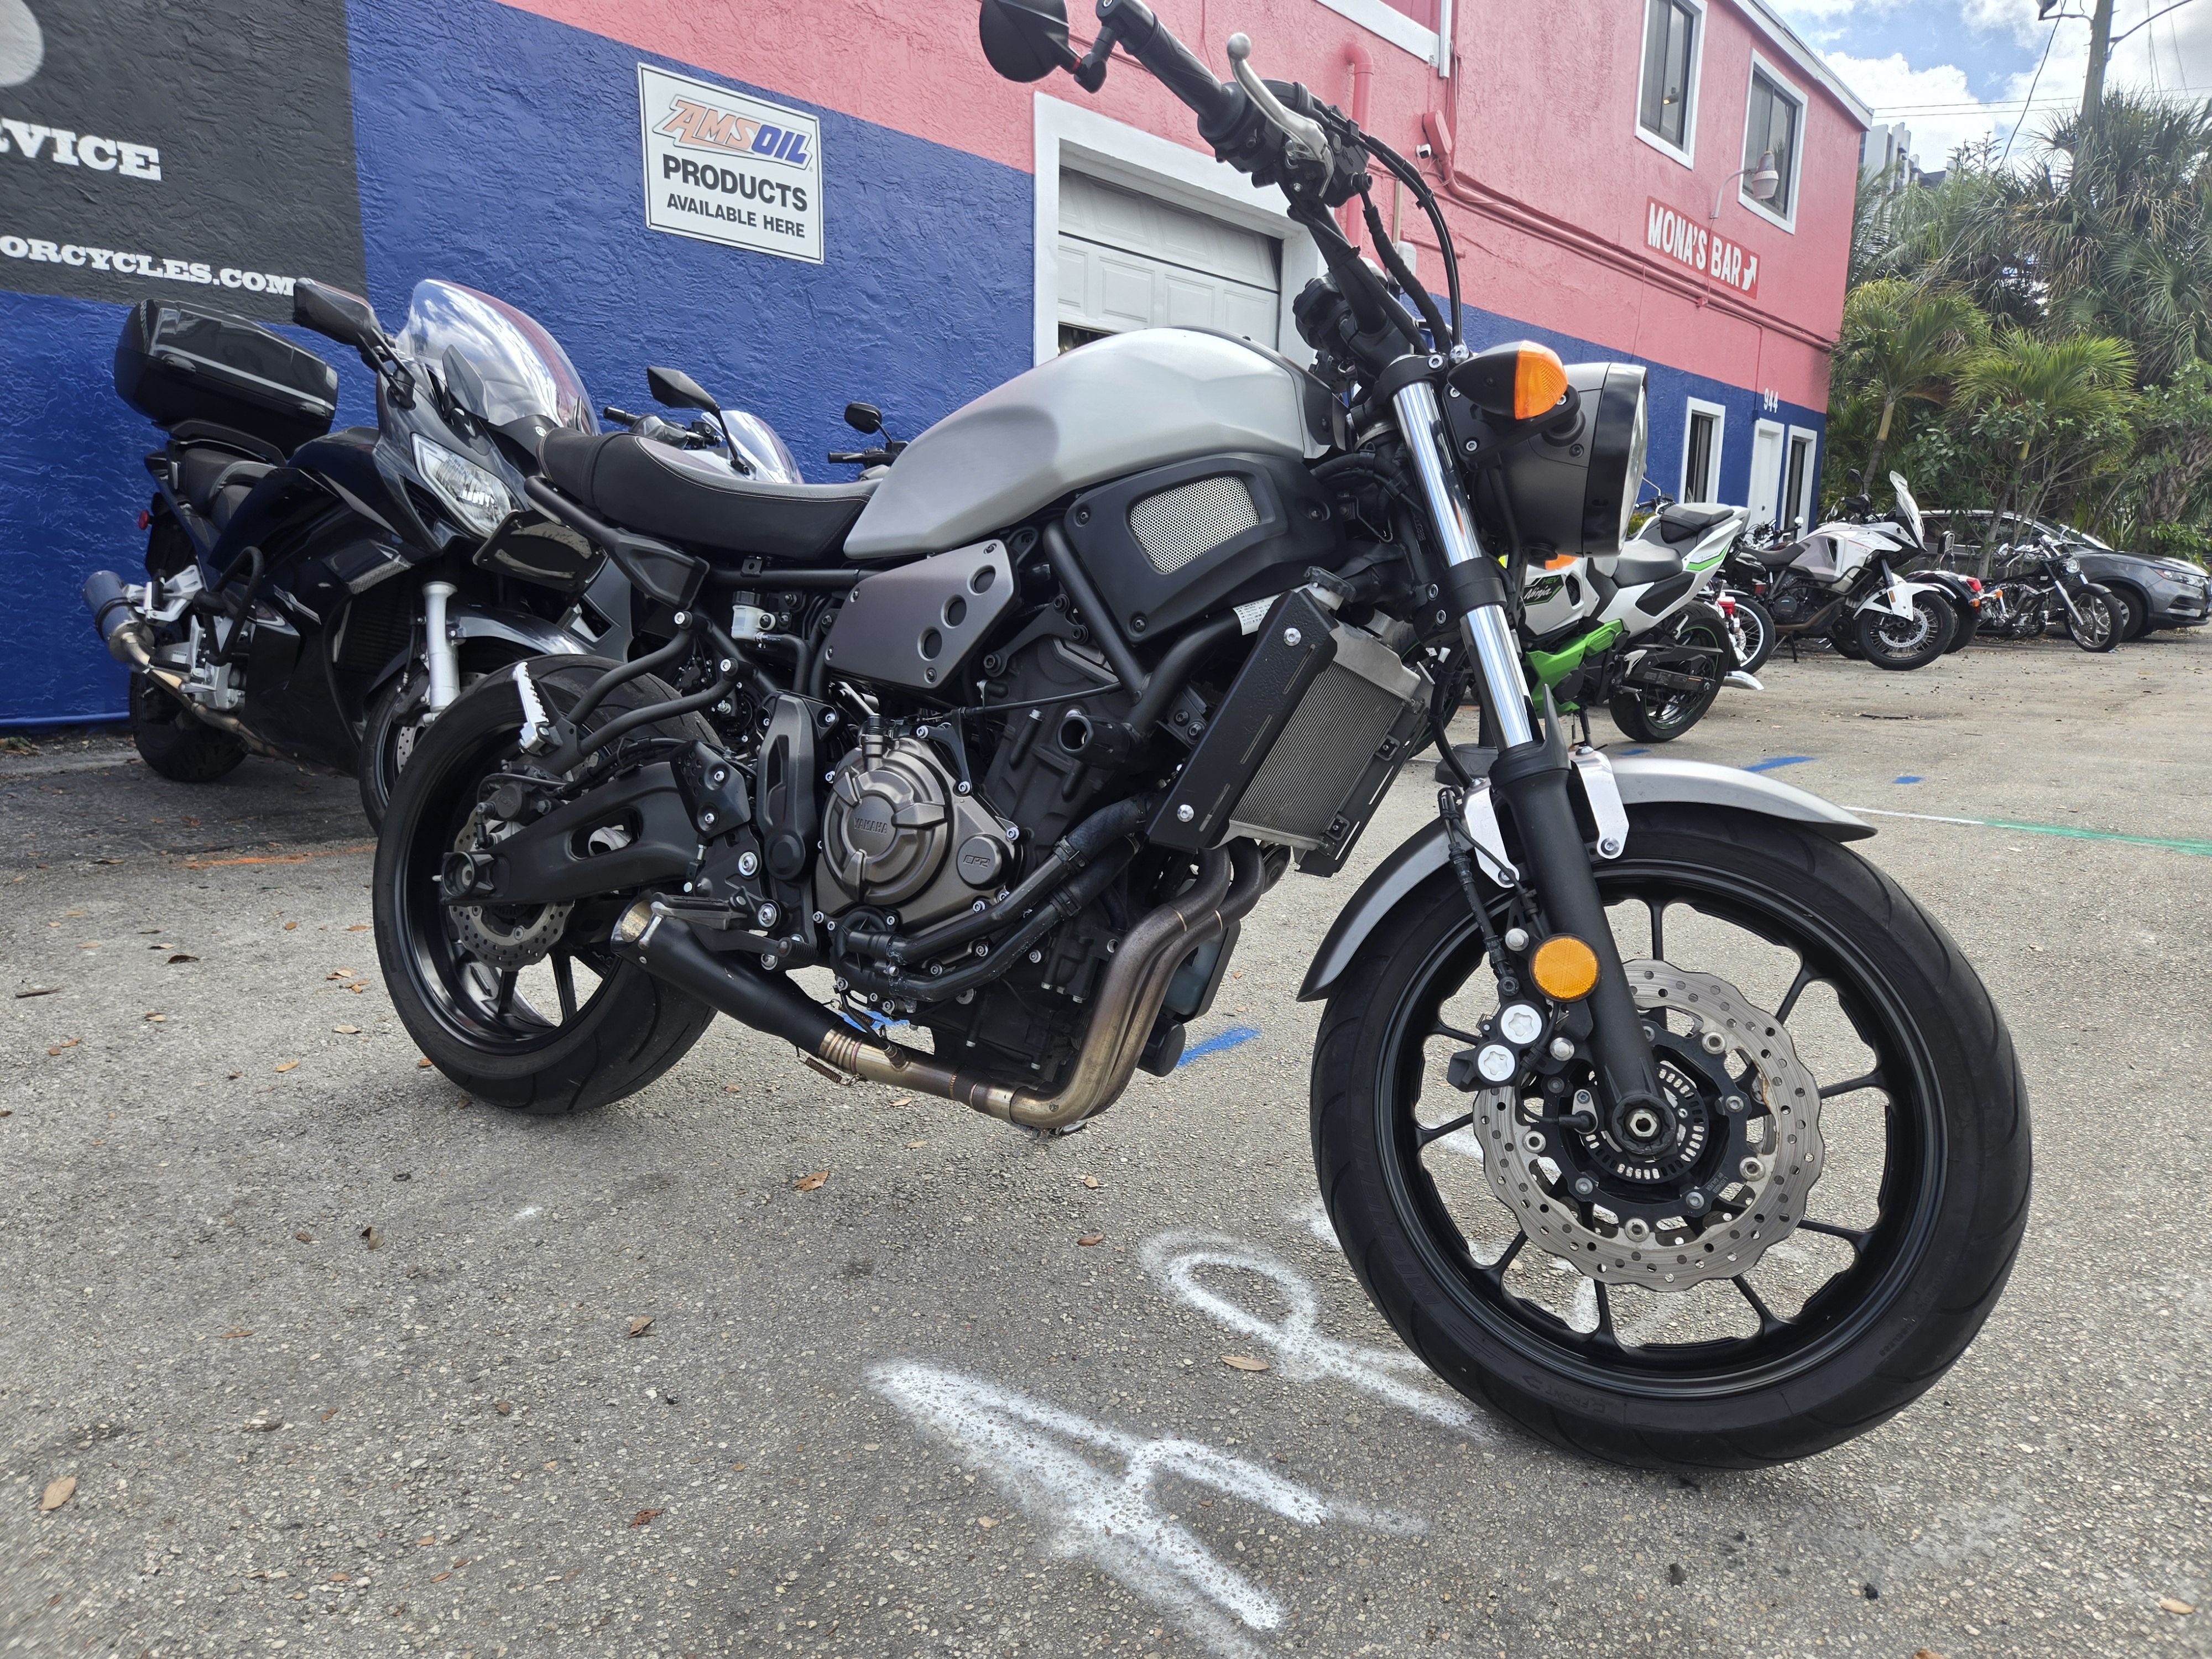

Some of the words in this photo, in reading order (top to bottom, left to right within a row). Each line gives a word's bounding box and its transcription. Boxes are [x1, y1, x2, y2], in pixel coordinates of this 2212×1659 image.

[662, 100, 807, 165] AMSOIL
[663, 154, 808, 212] PRODUCTS
[667, 193, 757, 227] AVAILABLE
[763, 215, 805, 238] HERE
[1647, 202, 1707, 270] MONA'S
[1710, 236, 1742, 288] BAR
[1764, 388, 1778, 413] 944
[1524, 585, 1552, 601] Ninja
[853, 817, 888, 834] YAMAHA
[1351, 1116, 1441, 1305] MICHELIN
